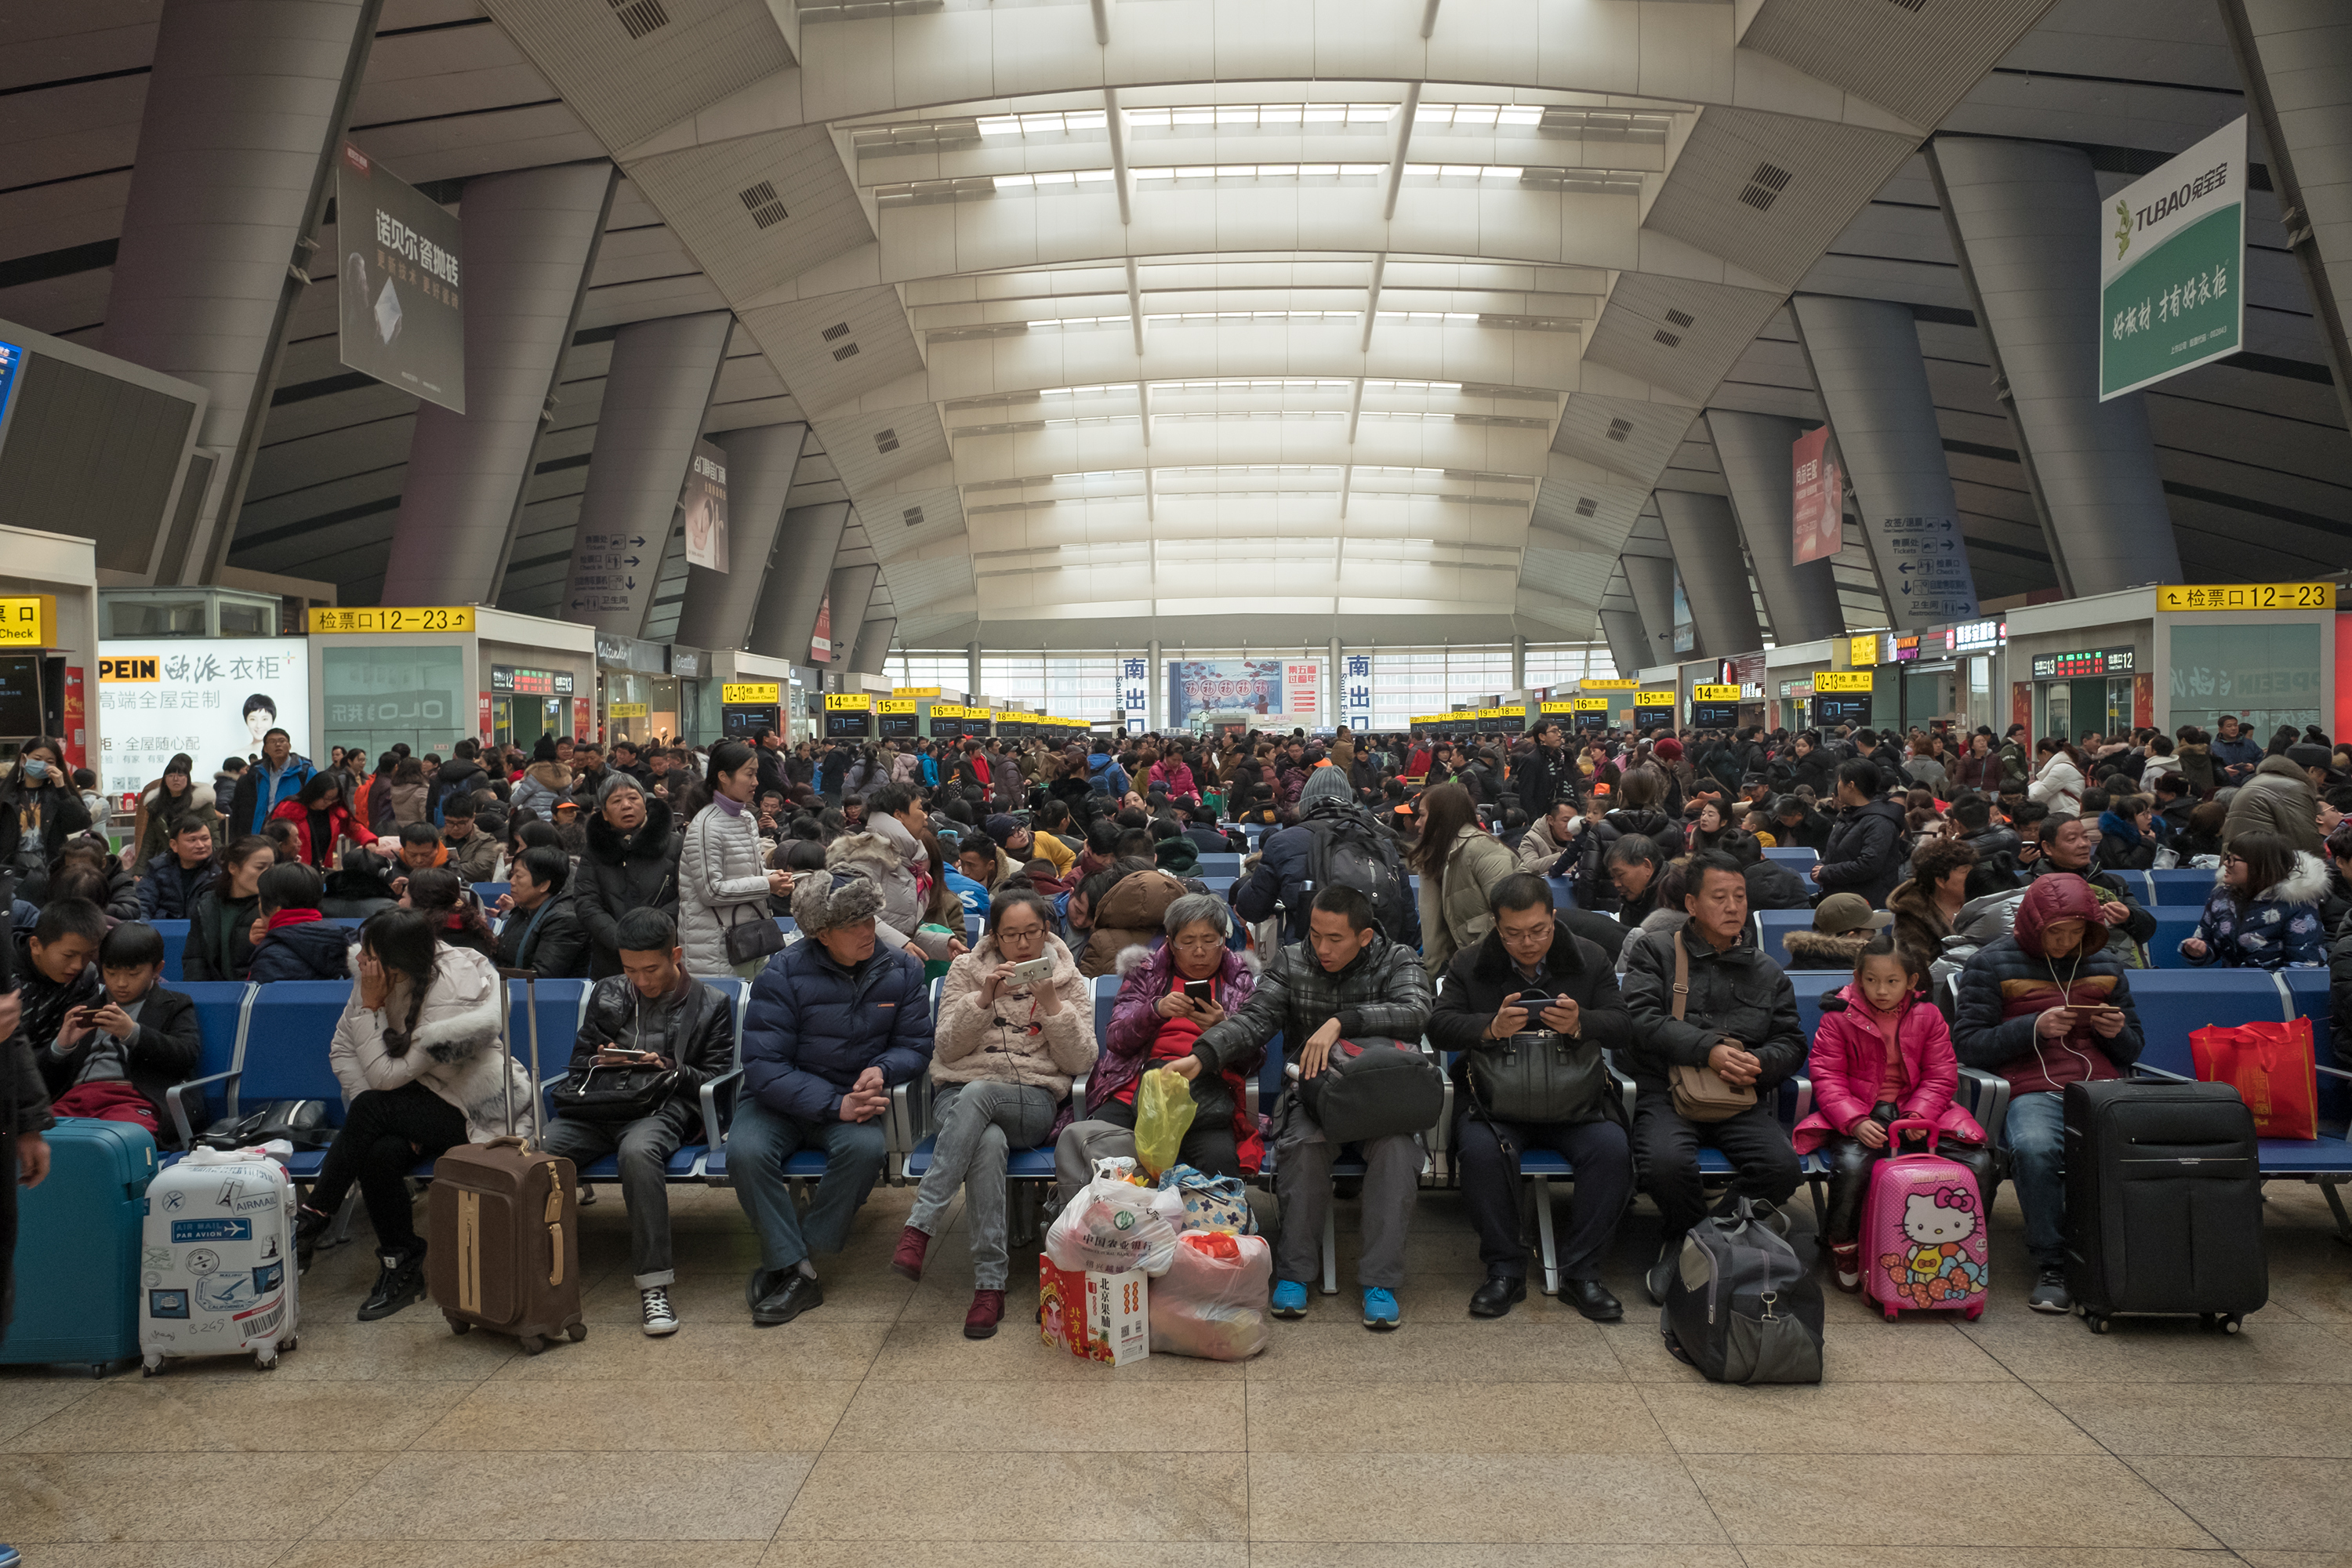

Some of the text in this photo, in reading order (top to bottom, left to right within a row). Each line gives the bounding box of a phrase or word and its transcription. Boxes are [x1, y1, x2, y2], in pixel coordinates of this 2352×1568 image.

[2135, 162, 2227, 232] TUBAO 兔宝宝
[2111, 263, 2227, 340] 好板材 才有好衣柜
[1911, 601, 1939, 609] 卫生间
[2047, 660, 2055, 674] 13
[2123, 652, 2132, 669] 12
[230, 656, 281, 681] 衣柜
[506, 673, 514, 688] 12
[1817, 673, 1838, 690] 12-13
[725, 686, 746, 701] 12-13
[1123, 658, 1145, 732] 南出口
[1347, 655, 1370, 730] 南出口
[1637, 693, 1650, 704] 15
[1697, 687, 1712, 699] 14
[100, 691, 220, 710] 高端全屋定制
[828, 696, 842, 708] 14
[878, 701, 891, 712] 15
[1542, 703, 1552, 712] 17
[1576, 700, 1587, 709] 16
[932, 706, 943, 716] 16
[238, 1194, 280, 1213] AIRMAIL
[198, 1232, 223, 1240] AVION
[1083, 1234, 1153, 1250] 中国农业银行
[209, 1305, 247, 1313] CALIFORNIA
[1100, 1278, 1111, 1328] 北京果脯
